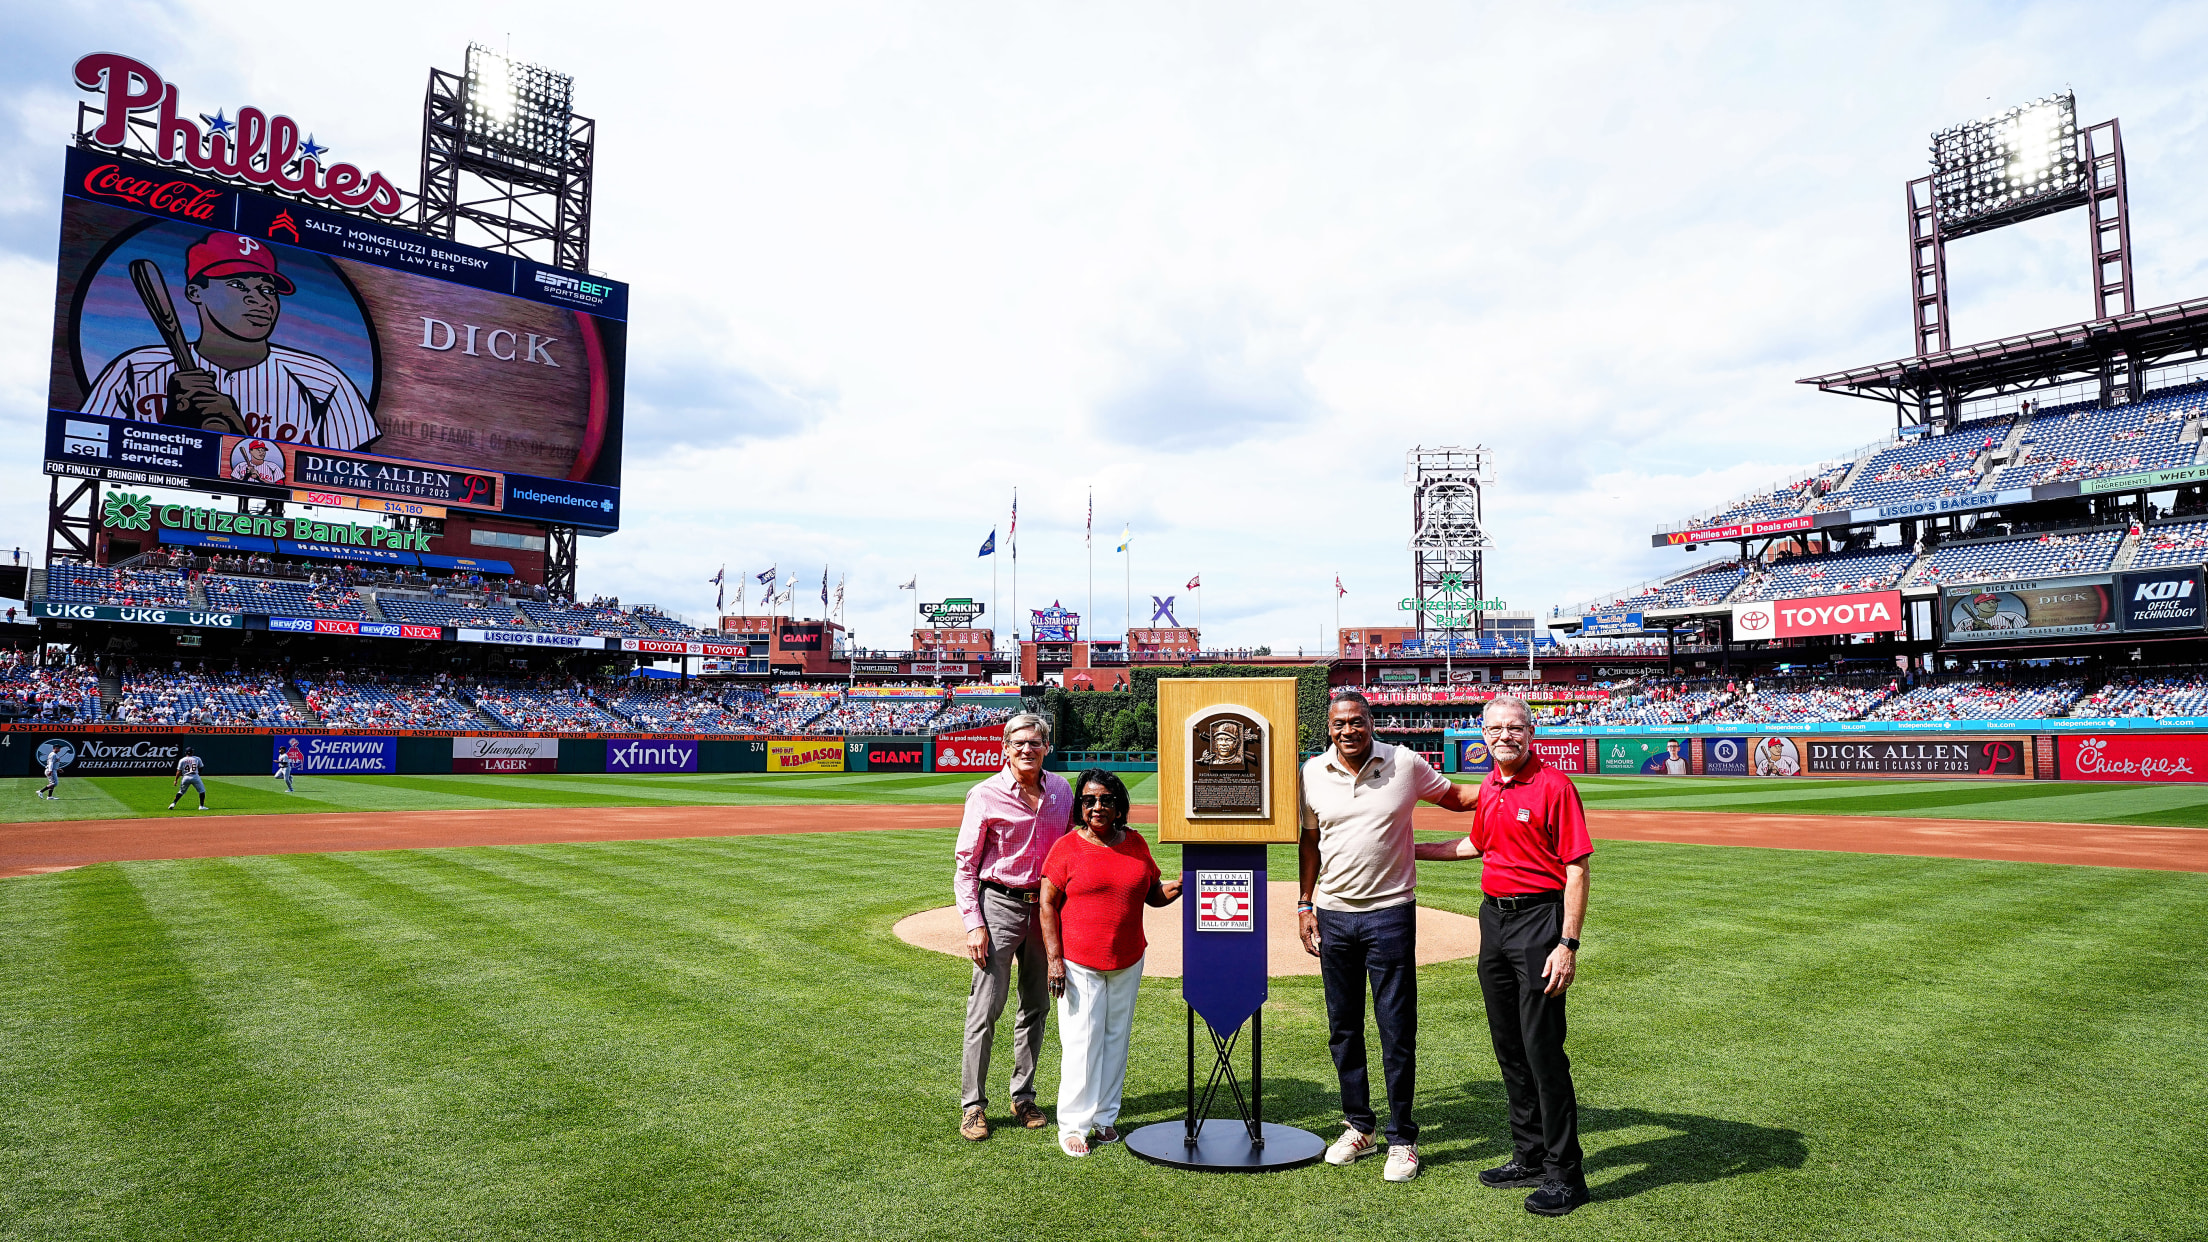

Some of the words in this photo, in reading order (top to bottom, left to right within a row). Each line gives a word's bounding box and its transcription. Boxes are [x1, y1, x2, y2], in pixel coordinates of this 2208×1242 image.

[72, 51, 402, 216] Phillies
[84, 164, 223, 221] Coca-Cola
[305, 219, 342, 236] SALTZ
[349, 229, 426, 255] MONGELUZZI
[431, 248, 489, 270] BENDESKY
[342, 241, 390, 257] INJURY
[400, 253, 455, 273] LAWYERS
[544, 286, 604, 304] SPORTSBOOK
[419, 316, 560, 368] DICK
[123, 427, 203, 449] Connecting
[122, 438, 183, 456] financial
[121, 452, 182, 468] services.
[47, 462, 64, 472] FOR
[67, 463, 100, 477] FINALLY
[107, 469, 147, 482] BRINGING
[148, 475, 164, 485] HIM
[166, 477, 190, 488] HOME.
[306, 455, 369, 477] DICK
[375, 466, 451, 488] ALLEN
[2160, 470, 2195, 481] WHEY
[306, 472, 329, 485] HALL
[334, 475, 344, 486] OF
[349, 478, 372, 489] FAME
[384, 482, 411, 493] CLASS
[415, 485, 425, 495] OF
[429, 487, 450, 498] 2025
[2095, 479, 2148, 490] INGREDIENTS
[513, 487, 599, 509] Independence
[384, 502, 423, 515] $14,180
[1879, 501, 1937, 517] LISCIO'S
[1941, 494, 1999, 510] BAKERY
[160, 504, 287, 538] Citizens
[294, 517, 366, 546] Bank
[371, 525, 431, 551] Park
[1757, 523, 1781, 532] Deals
[1783, 520, 1798, 529] roll
[1800, 519, 1809, 527] in
[1690, 532, 1720, 541] Phillies
[1722, 528, 1737, 537] win
[297, 543, 350, 555] HARRY
[1986, 585, 2006, 593] DICK
[2010, 583, 2037, 591] ALLEN
[2134, 580, 2194, 601] KDI
[1401, 598, 1462, 611] Citizens
[1466, 597, 1504, 611] Bank
[2039, 593, 2088, 605] DICK
[2147, 600, 2180, 611] OFFICE
[1781, 602, 1891, 627] TOYOTA
[2133, 607, 2196, 620] TECHNOLOGY
[1436, 614, 1469, 627] Park
[317, 621, 358, 634] NECA
[403, 626, 441, 638] NECA
[484, 631, 533, 643] LISCIO'S
[536, 634, 581, 646] BAKERY
[783, 634, 818, 643] GIANT
[642, 640, 684, 652] TOYOTA
[706, 645, 745, 656] TOYOTA
[8, 724, 87, 732] ASPLUNDH
[102, 725, 174, 733] ASPLUNDH
[188, 726, 255, 734] ASPLUNDH
[268, 727, 330, 735] ASPLUNDH
[342, 728, 400, 736] ASPLUNDH
[411, 729, 466, 737] ASPLUNDH
[476, 730, 529, 738] ASPLUNDH
[538, 731, 587, 739] ASPLUNDH
[77, 740, 178, 758] NovaCare
[309, 739, 384, 754] SHERWIN
[473, 739, 540, 757] Yuengling
[751, 743, 764, 752] 374
[850, 743, 864, 753] 387
[1533, 743, 1580, 758] Temple
[1812, 745, 1873, 759] DICK
[1883, 745, 1969, 759] ALLEN
[612, 742, 693, 768] xfinity
[869, 751, 921, 763] GIANT
[961, 749, 998, 766] State
[2076, 742, 2194, 777] Chick-fil-A
[77, 761, 174, 769] REHABILITATION
[184, 764, 196, 772] 46
[485, 760, 527, 770] LAGER
[1814, 761, 1836, 771] HALL
[1841, 761, 1851, 771] OF
[1856, 761, 1880, 771] FAME
[1893, 761, 1922, 771] CLASS
[1927, 761, 1938, 771] OF
[1944, 761, 1969, 771] 2025
